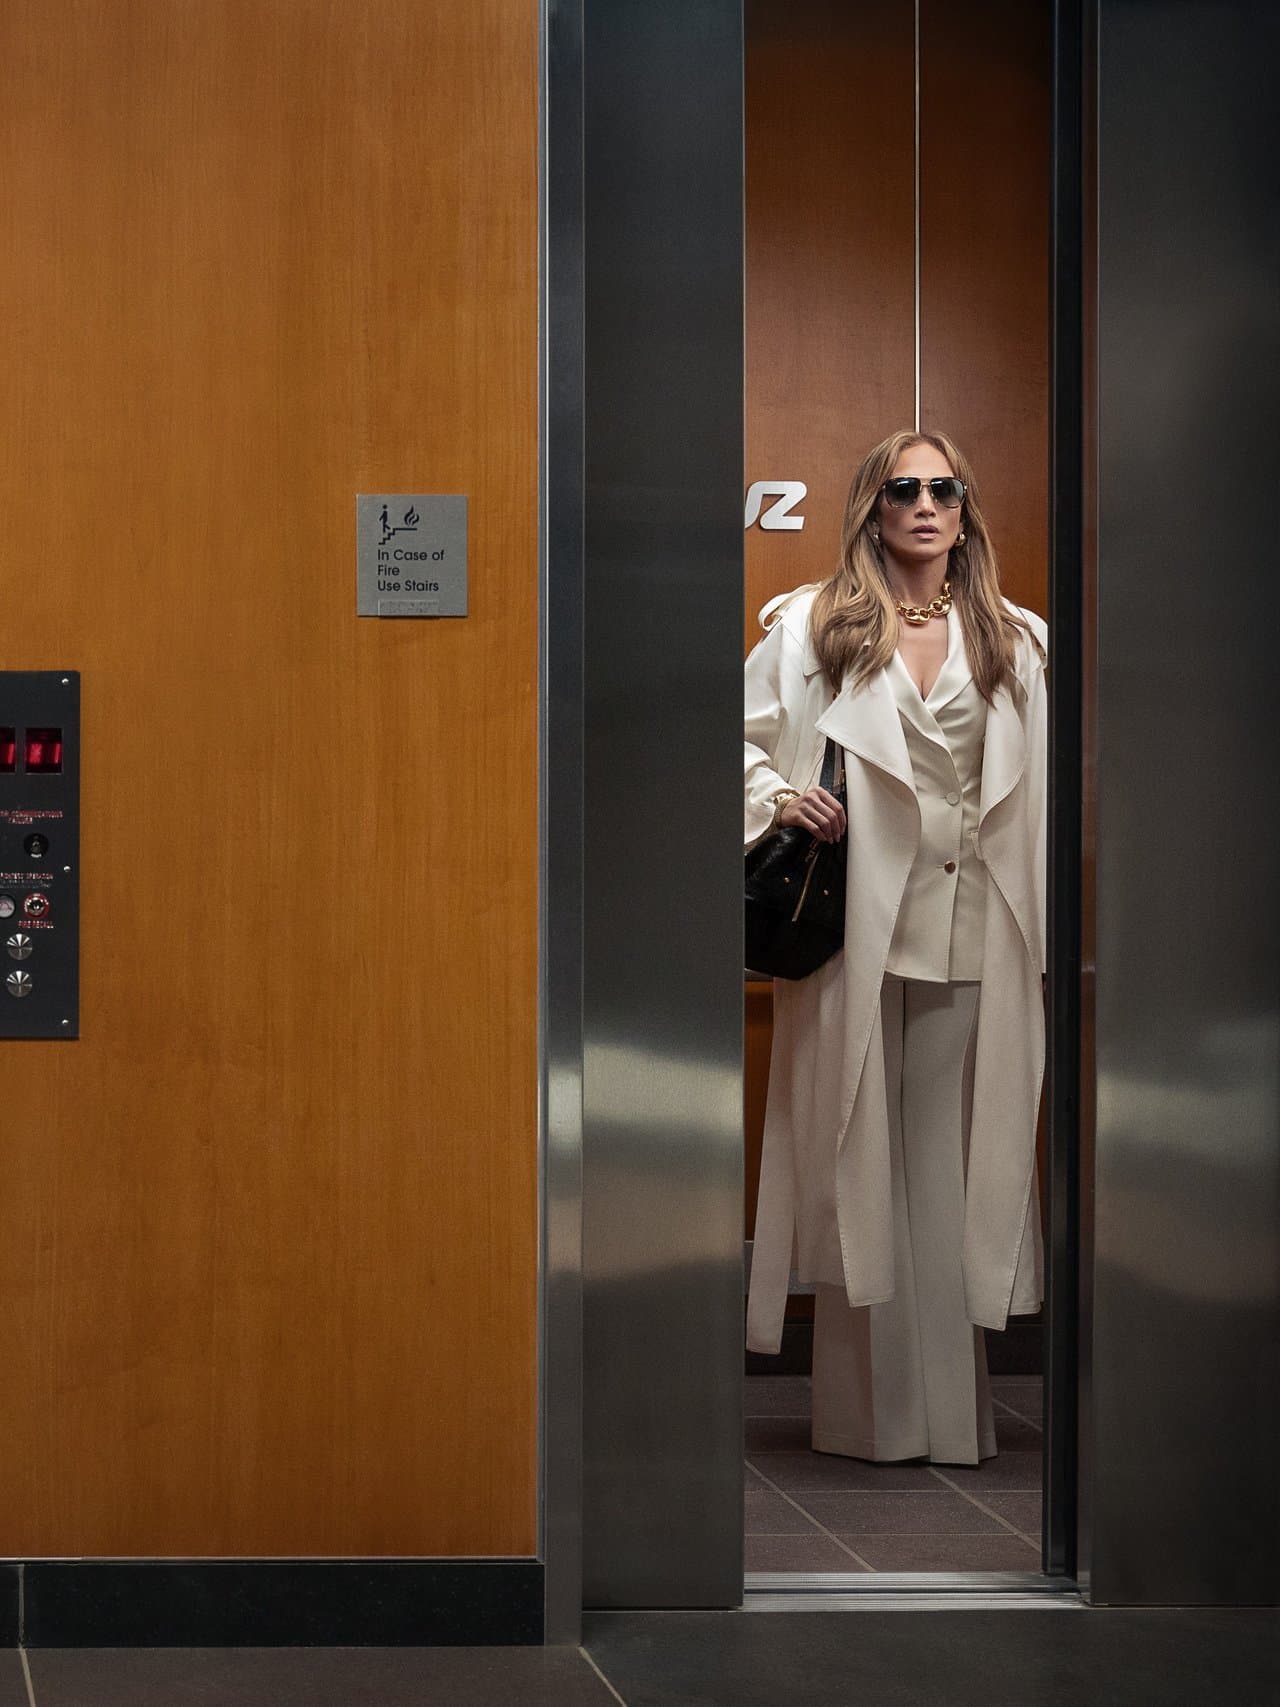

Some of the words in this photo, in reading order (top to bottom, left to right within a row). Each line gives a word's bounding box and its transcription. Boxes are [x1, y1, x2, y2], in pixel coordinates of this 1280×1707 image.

[377, 549, 389, 560] In
[393, 549, 428, 561] Case
[432, 549, 445, 561] of
[377, 564, 400, 576] Fire
[377, 580, 401, 591] Use
[404, 580, 439, 591] Stairs
